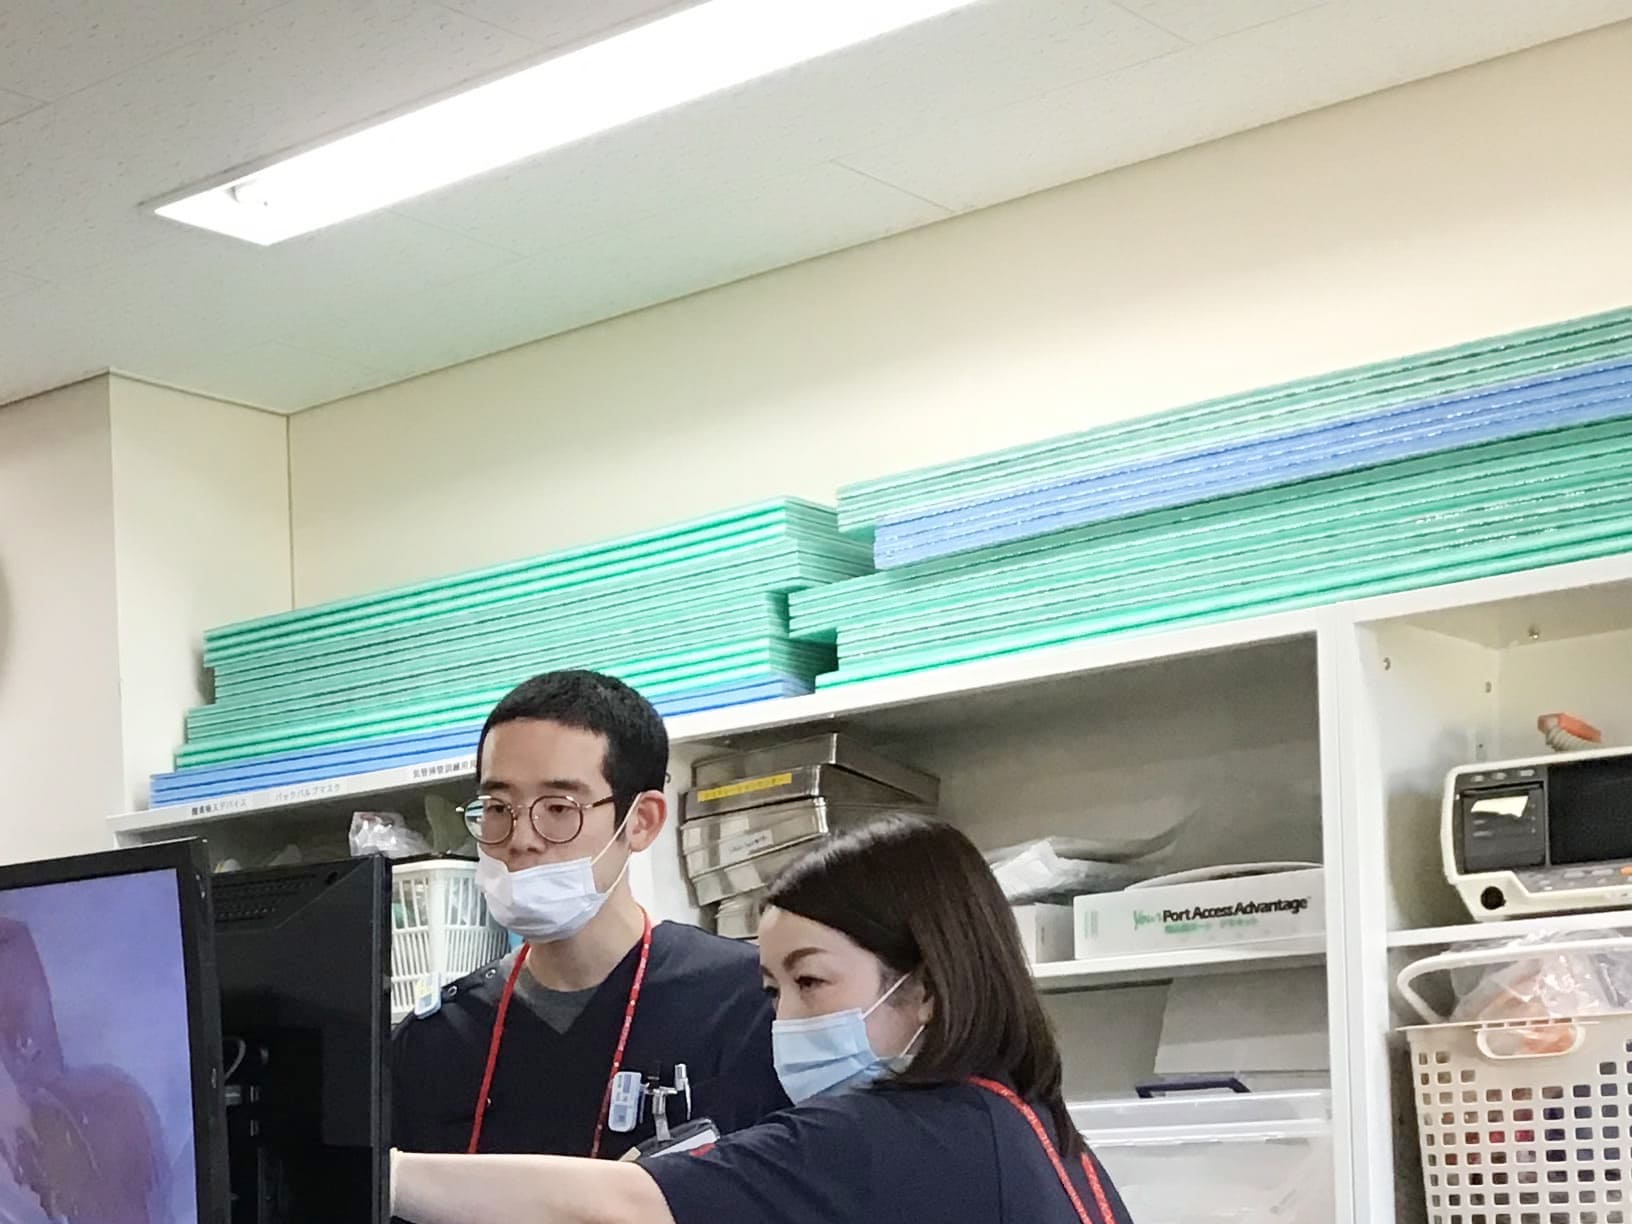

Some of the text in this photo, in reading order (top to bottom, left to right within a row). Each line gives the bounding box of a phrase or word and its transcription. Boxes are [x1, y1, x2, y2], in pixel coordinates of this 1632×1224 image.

[1163, 908, 1191, 923] Port
[1191, 903, 1233, 920] Access
[1234, 897, 1308, 915] Advantage
